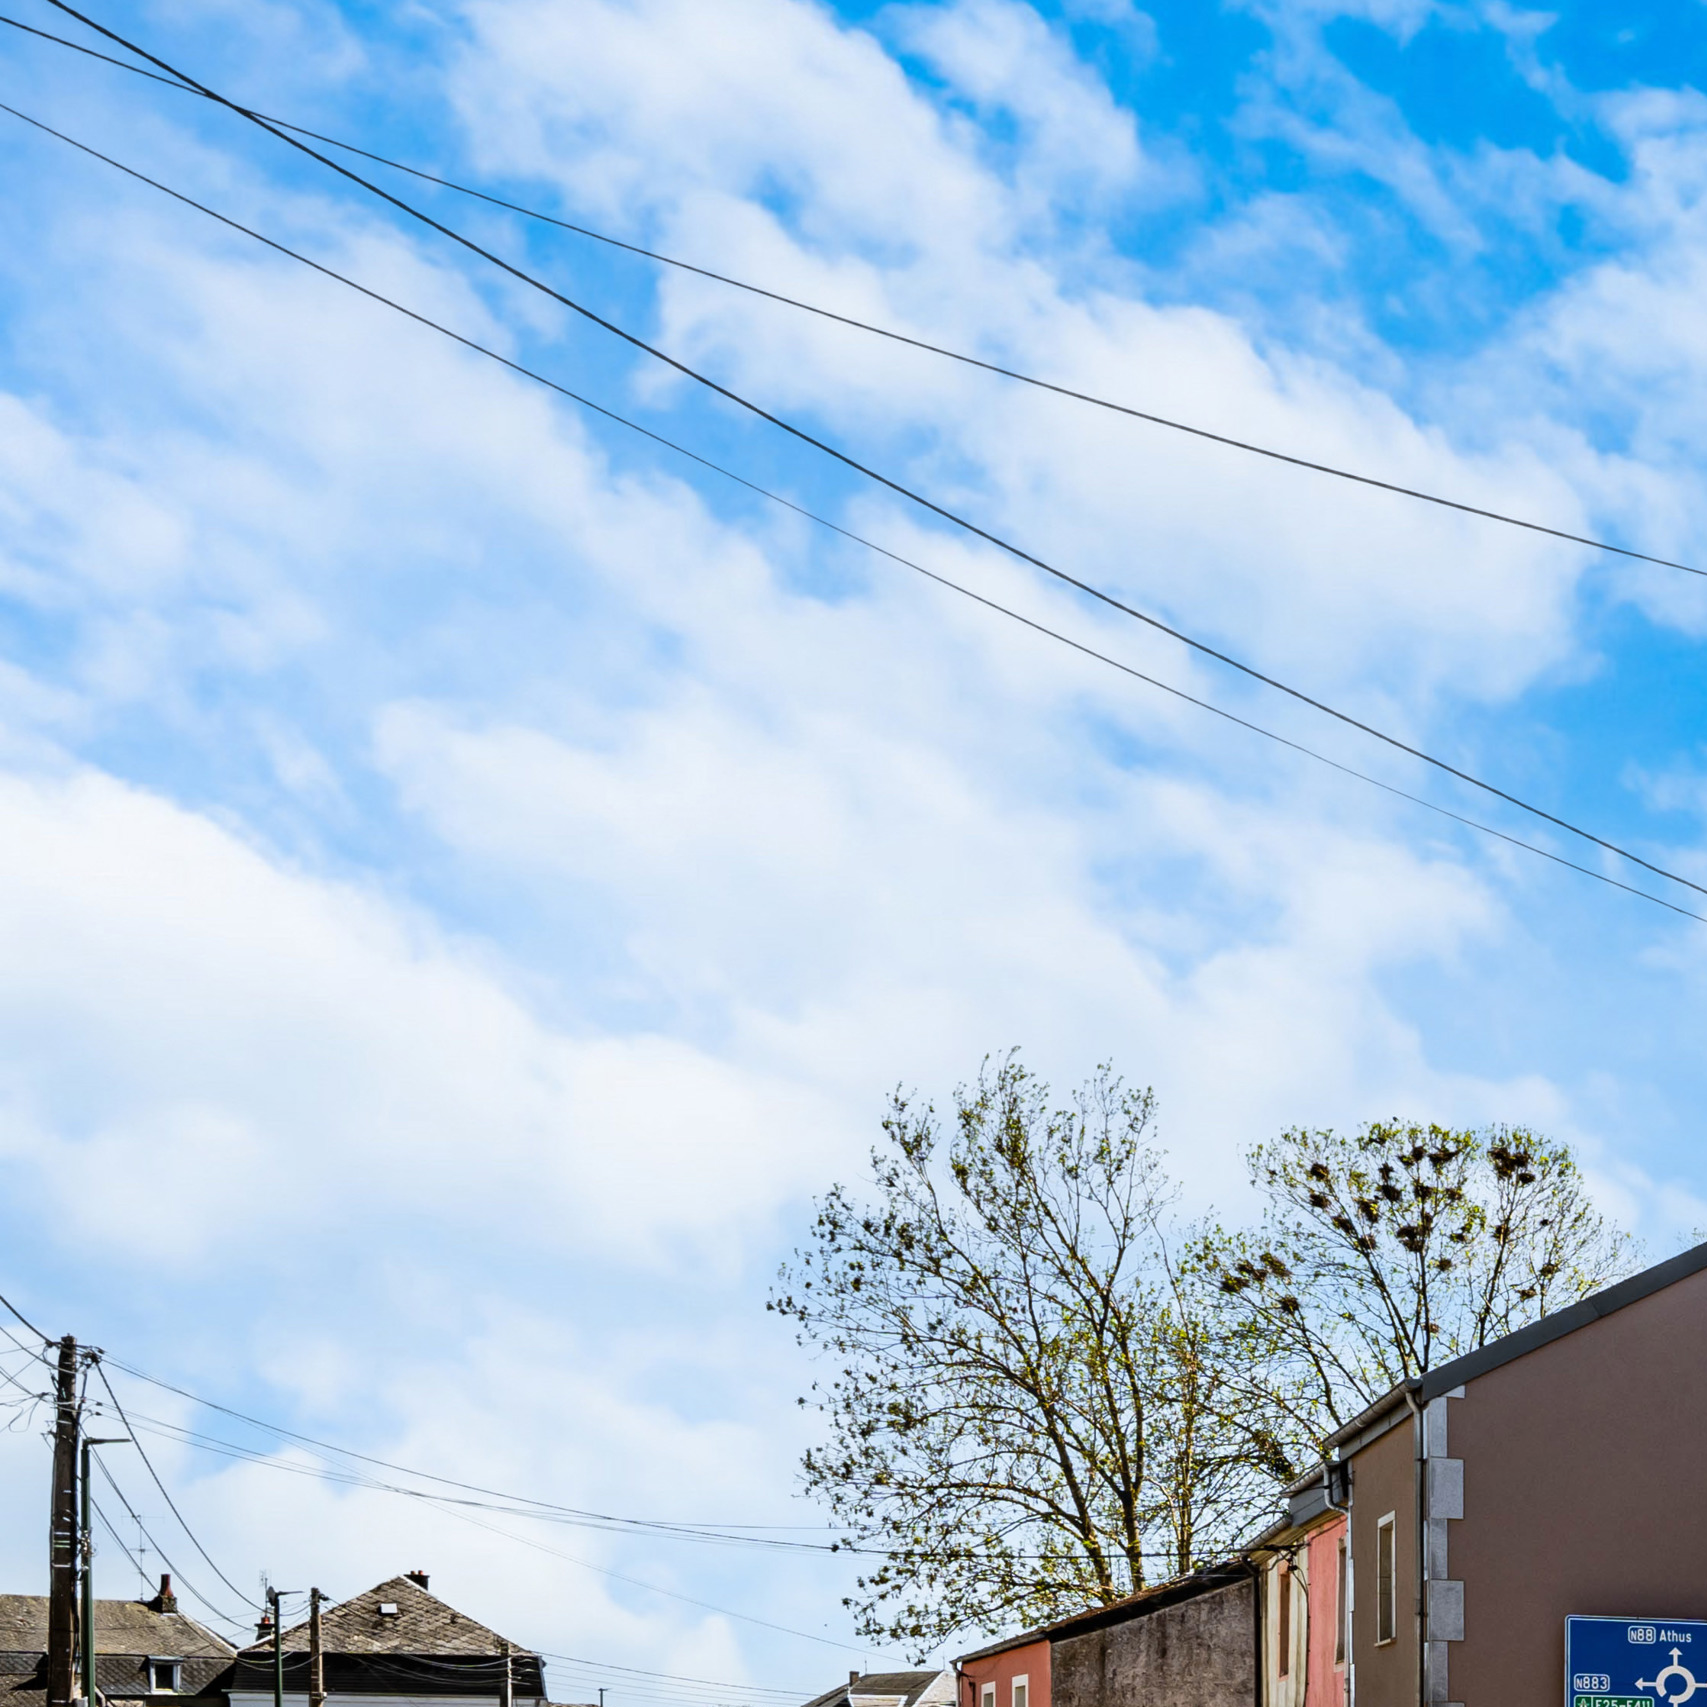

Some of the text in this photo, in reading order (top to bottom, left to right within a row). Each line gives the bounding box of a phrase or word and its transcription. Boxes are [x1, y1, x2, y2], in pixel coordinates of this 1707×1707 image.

[1631, 1629, 1692, 1642] N88 Athus
[1576, 1677, 1607, 1689] N883
